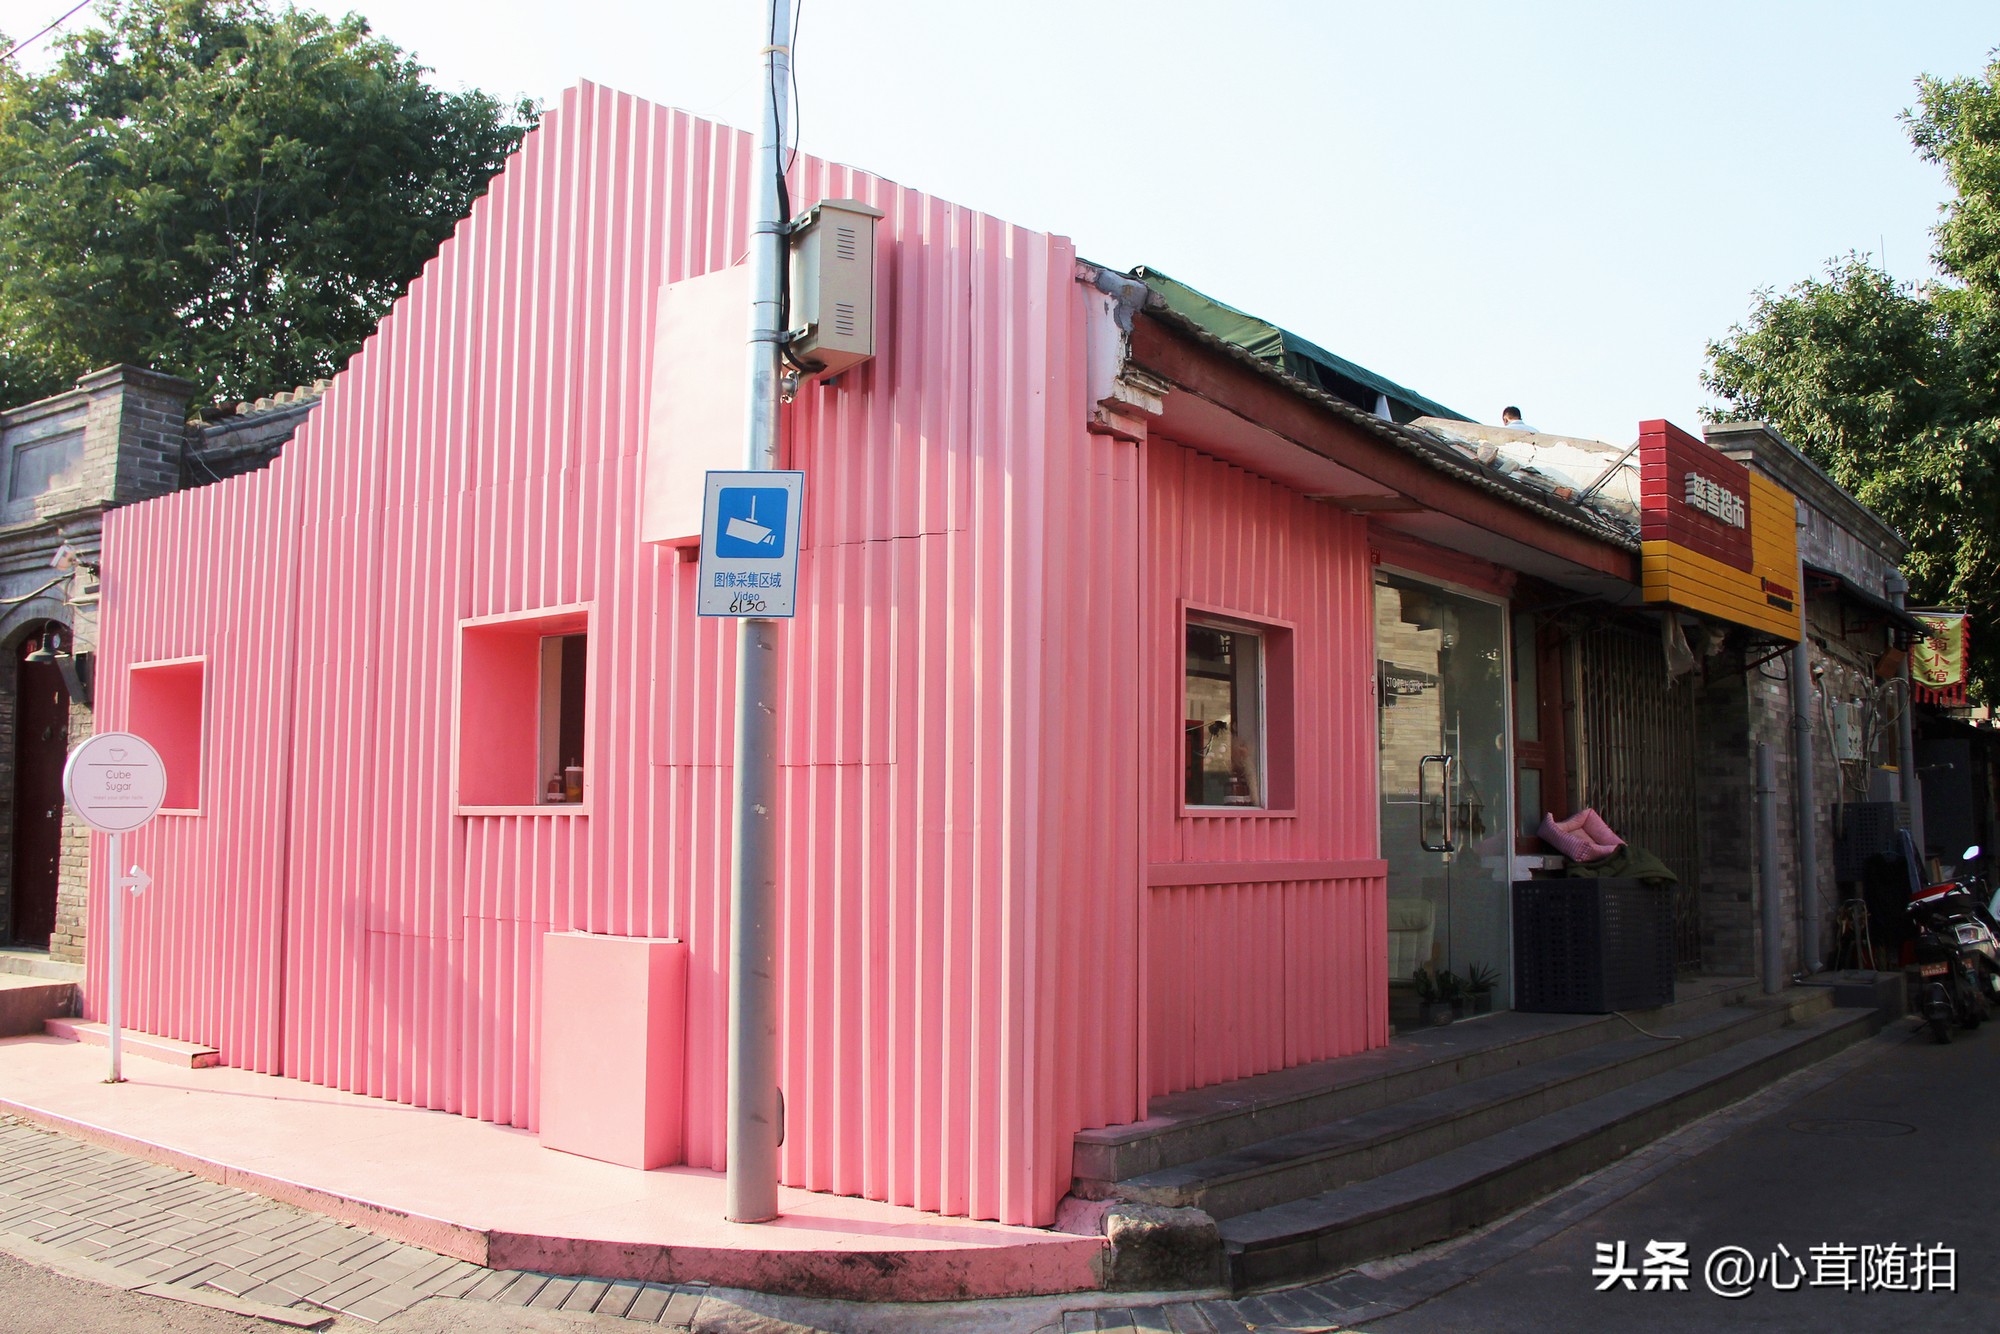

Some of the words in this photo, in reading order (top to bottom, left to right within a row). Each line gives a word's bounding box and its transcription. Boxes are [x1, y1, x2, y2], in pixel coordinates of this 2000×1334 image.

[1686, 472, 1745, 529] 慈善超市
[714, 572, 781, 588] 图像采集区域
[734, 592, 759, 601] Video
[729, 600, 766, 613] 6130
[1923, 621, 1950, 683] 醉翁小馆
[106, 770, 131, 779] Cube
[106, 781, 131, 792] Sugar
